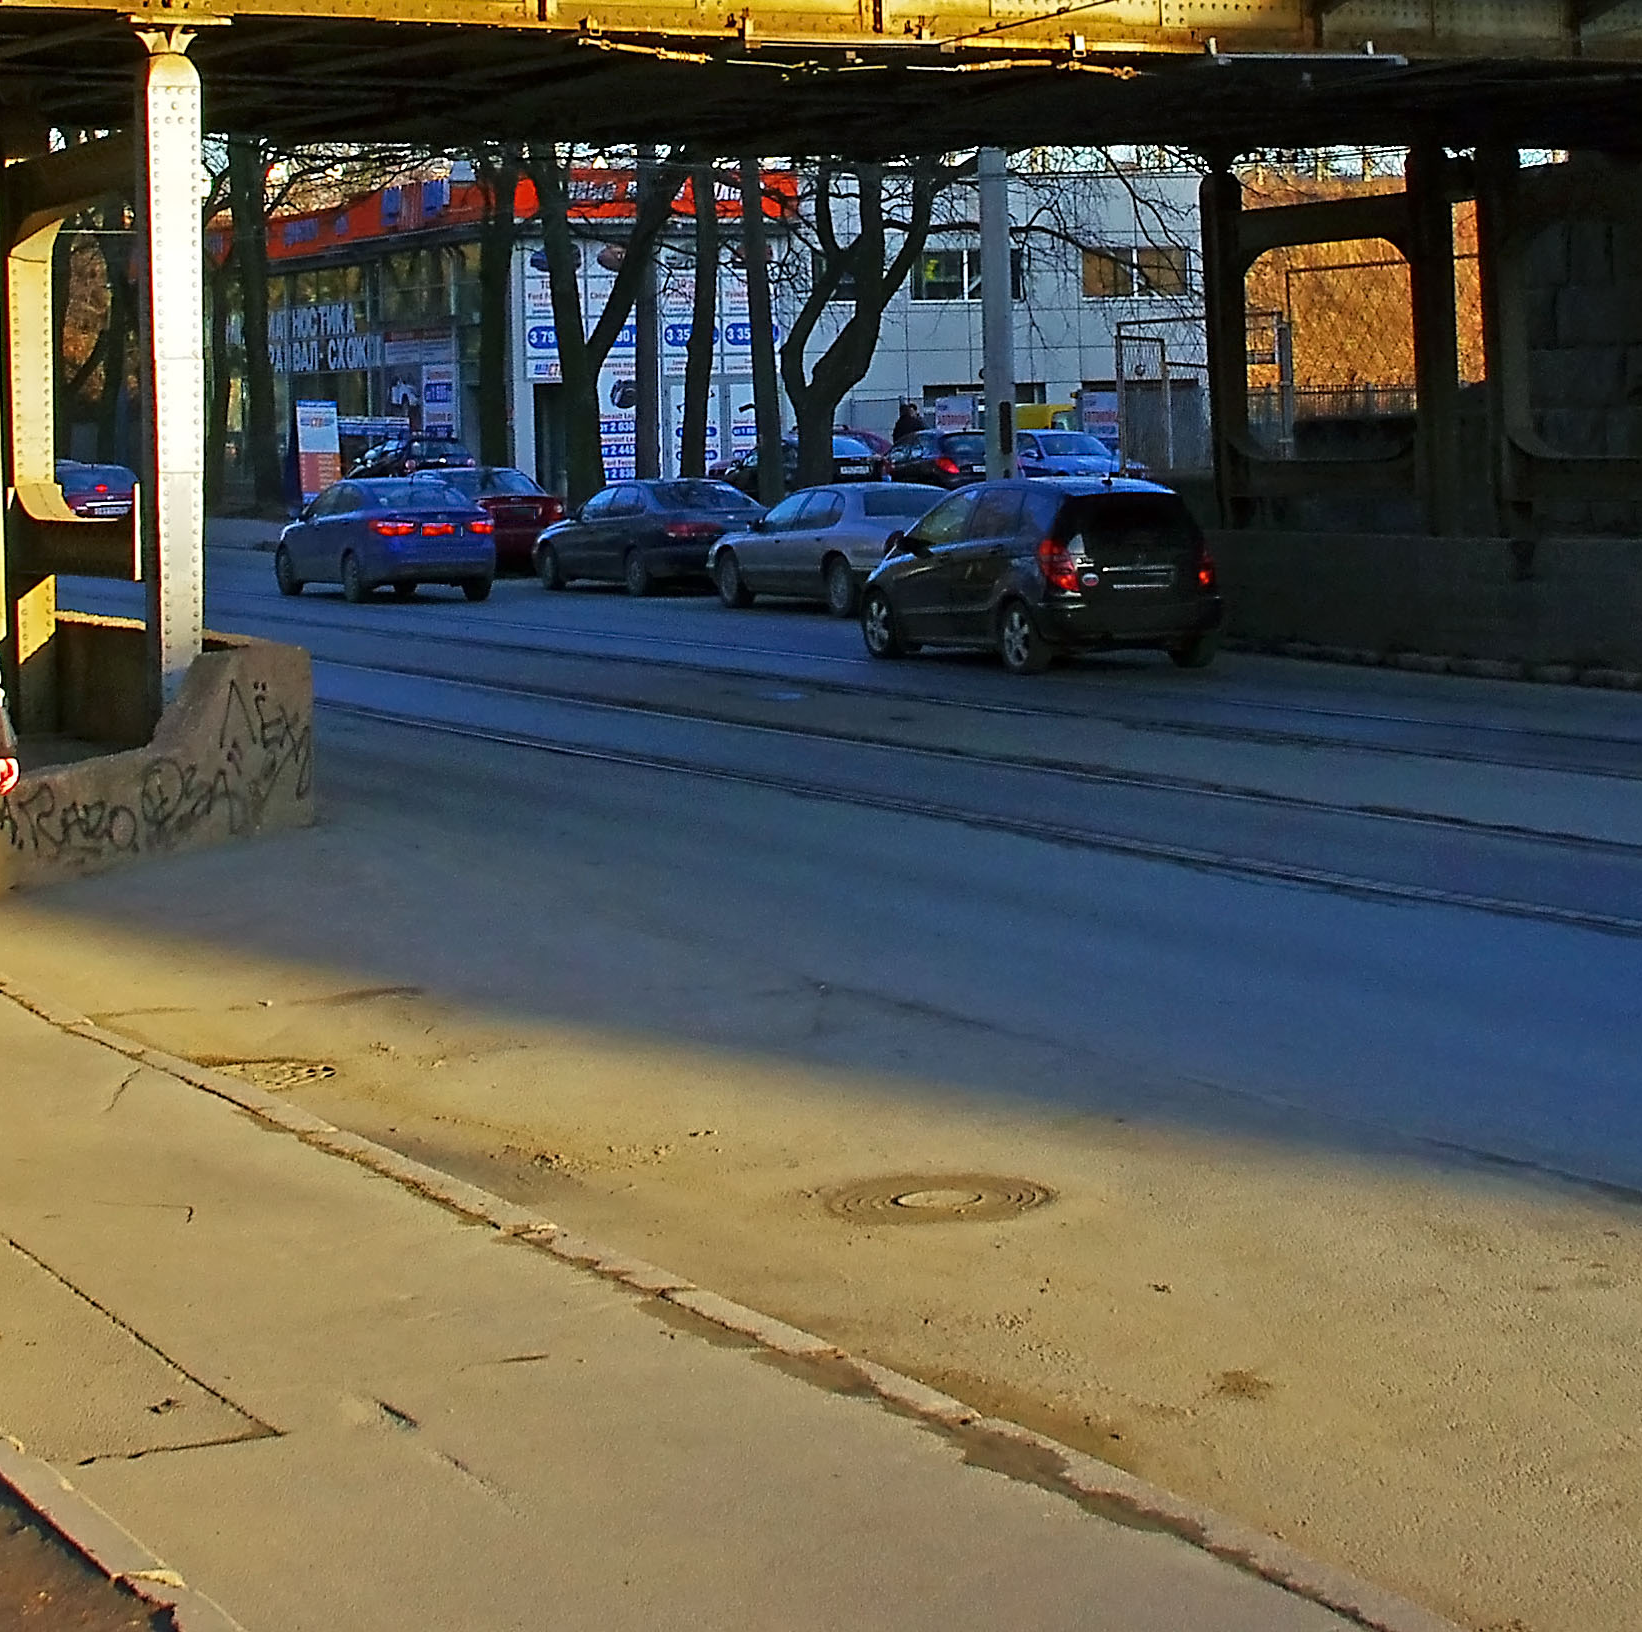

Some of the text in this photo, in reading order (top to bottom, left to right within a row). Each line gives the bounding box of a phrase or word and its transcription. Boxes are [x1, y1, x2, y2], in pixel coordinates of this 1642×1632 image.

[541, 331, 556, 344] 79
[676, 328, 692, 341] 35
[737, 328, 751, 340] 35
